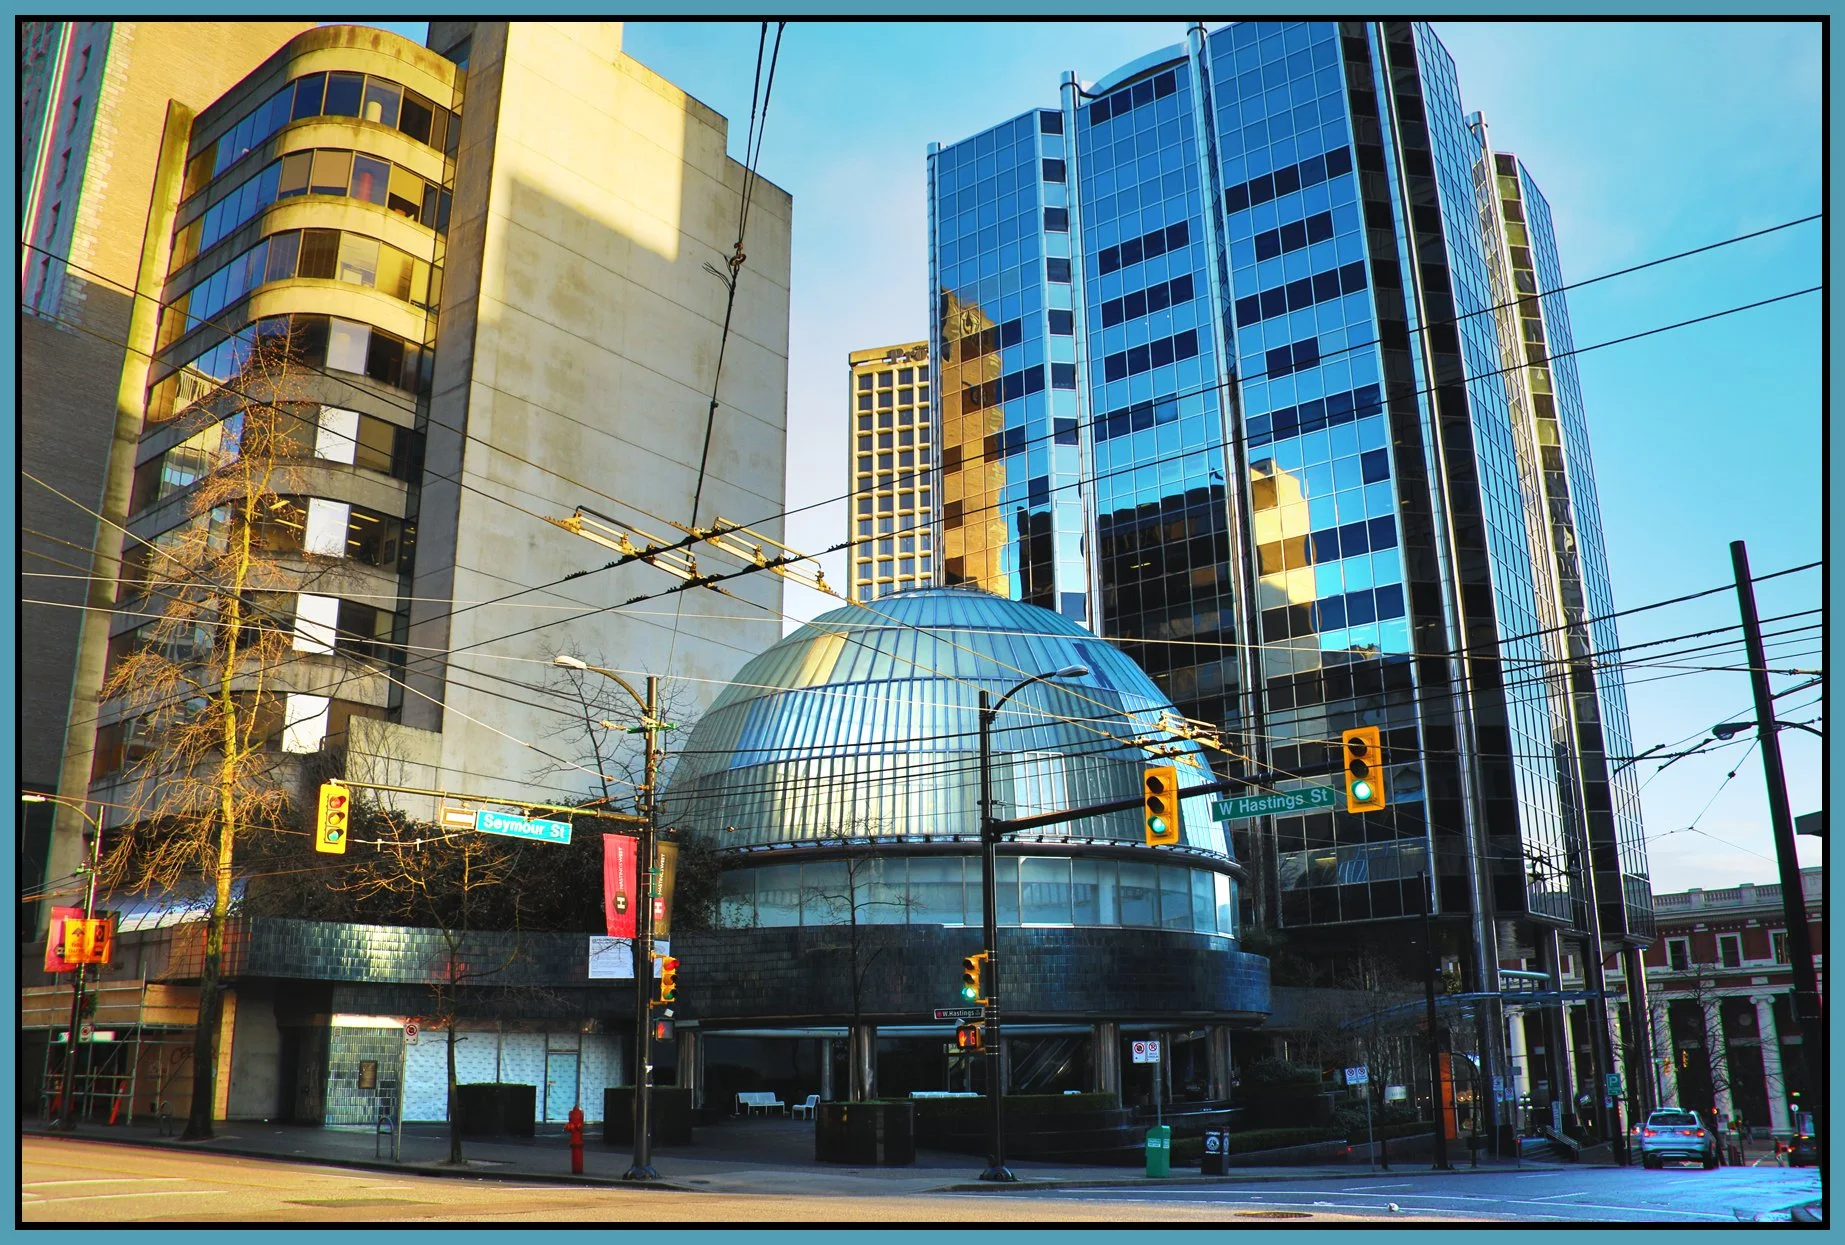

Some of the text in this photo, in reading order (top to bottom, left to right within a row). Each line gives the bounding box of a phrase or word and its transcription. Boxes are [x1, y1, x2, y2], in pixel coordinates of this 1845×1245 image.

[1219, 788, 1328, 815] W Hastings St
[483, 813, 566, 839] Seymour St
[616, 896, 626, 909] H
[654, 902, 663, 914] H
